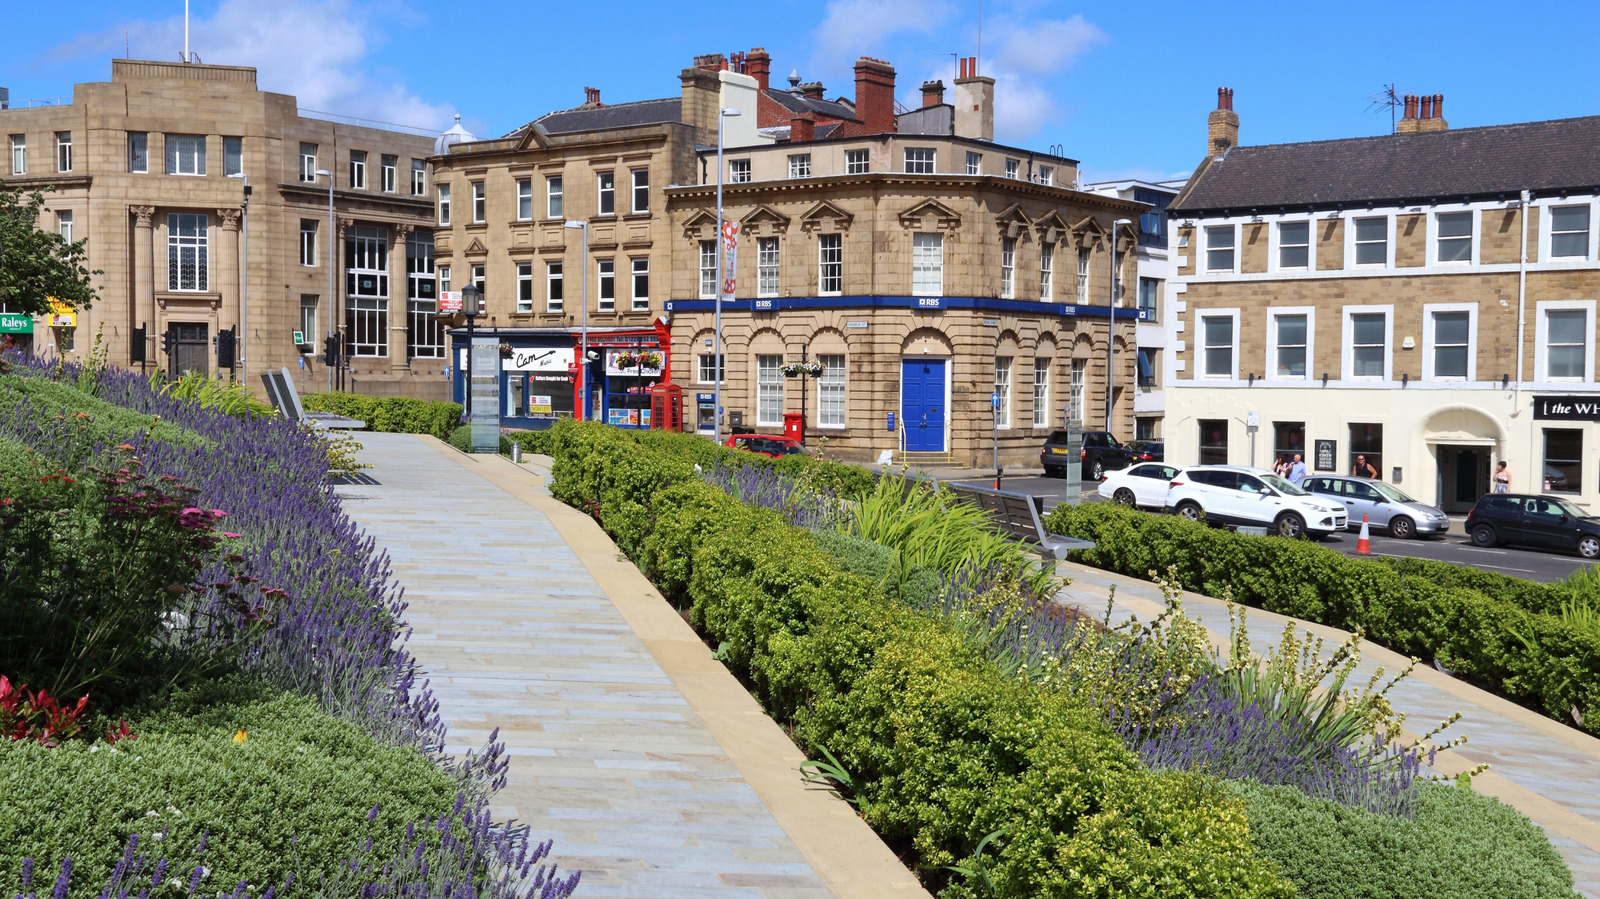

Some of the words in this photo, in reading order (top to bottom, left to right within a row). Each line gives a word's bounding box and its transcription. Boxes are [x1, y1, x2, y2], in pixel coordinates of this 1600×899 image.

[926, 298, 940, 306] RBS
[1, 316, 27, 330] Raleys
[1552, 403, 1572, 414] the
